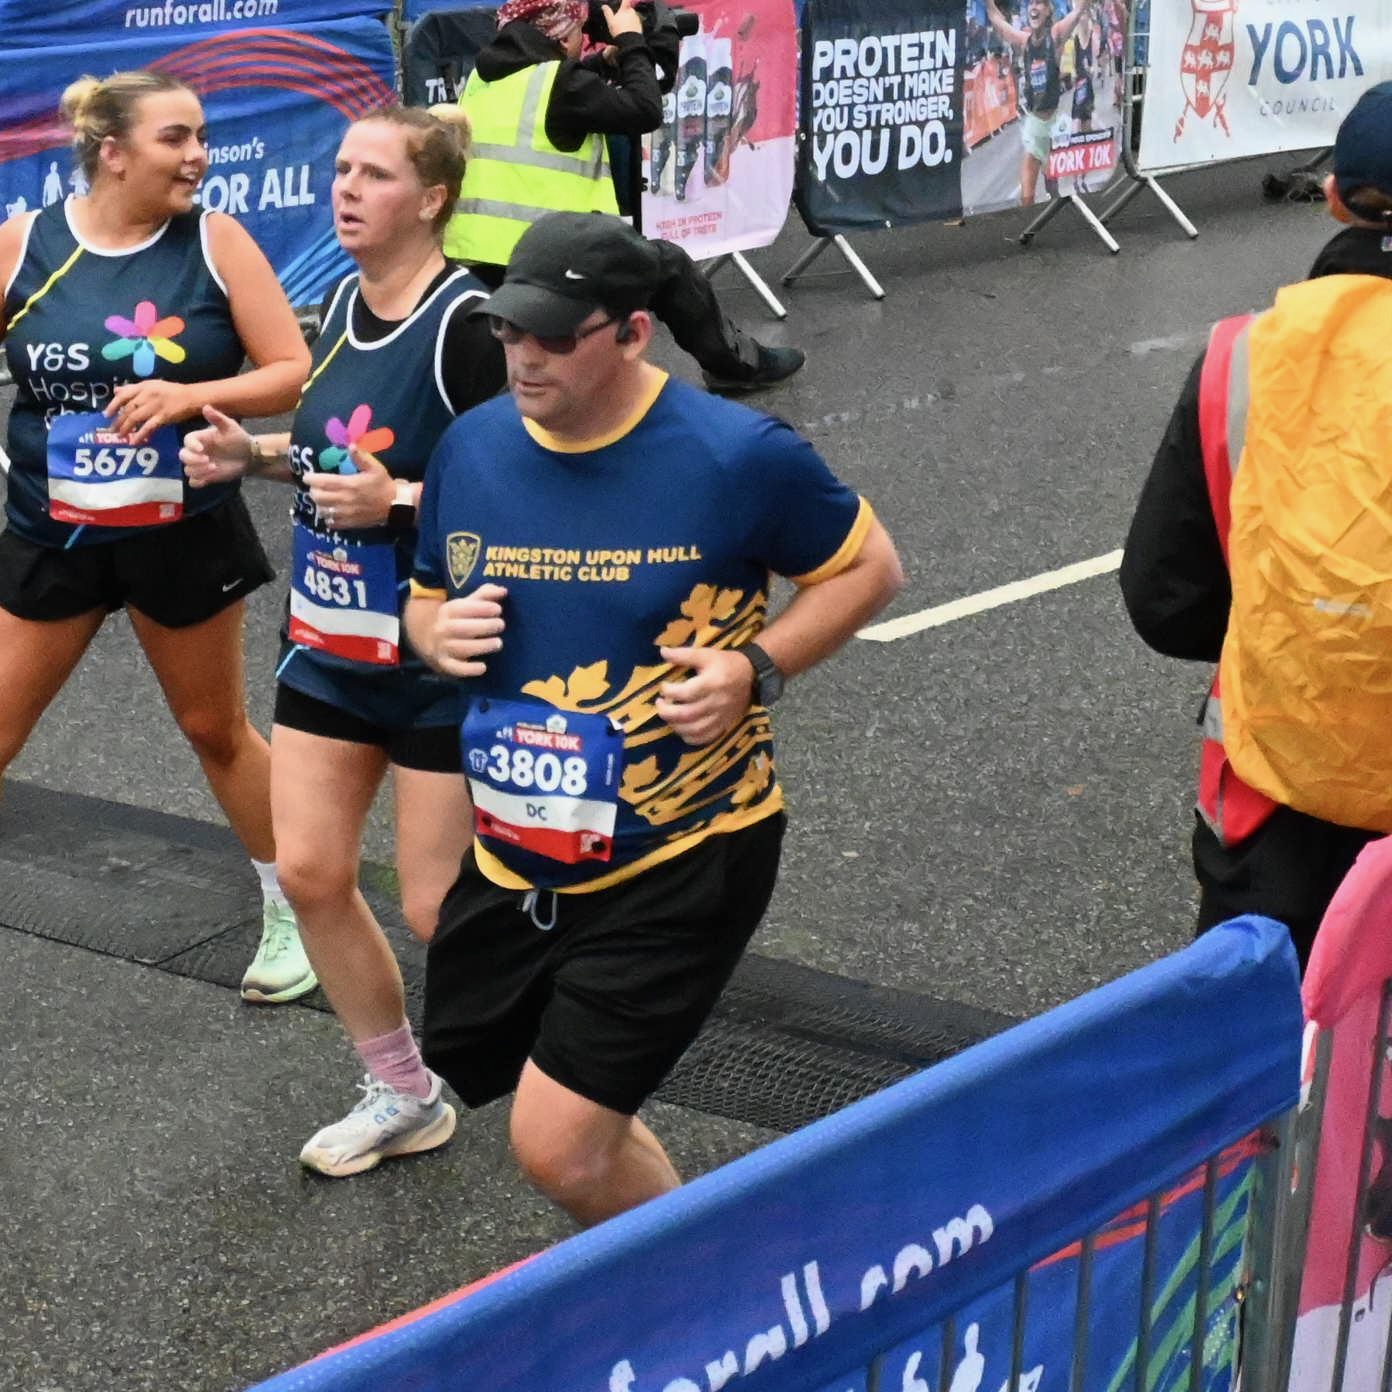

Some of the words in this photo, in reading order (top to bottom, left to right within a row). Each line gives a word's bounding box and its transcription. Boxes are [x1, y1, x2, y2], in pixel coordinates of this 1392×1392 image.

[812, 28, 956, 81] PROTEIN
[1245, 15, 1364, 87] YORK
[812, 77, 901, 108] DOESN'T
[904, 68, 954, 98] MAKE
[812, 107, 848, 132] YOU
[852, 98, 953, 128] STRONGER,
[1259, 95, 1336, 118] COUNCIL
[812, 128, 890, 181] YOU
[898, 121, 952, 170] DO.
[1049, 148, 1086, 176] YORK
[1089, 143, 1112, 169] 10K
[258, 163, 316, 211] ALL
[28, 376, 122, 404] Hospi
[73, 447, 159, 477] 5679
[485, 545, 581, 565] KINGSTON
[585, 549, 642, 565] UPON
[647, 543, 702, 564] HULL
[303, 566, 368, 609] 4831
[483, 561, 572, 581] ATHLETIC
[577, 565, 631, 582] CLUB
[515, 727, 553, 748] YORK
[554, 734, 582, 752] 10K
[487, 744, 588, 796] 3808
[526, 803, 548, 821] DC
